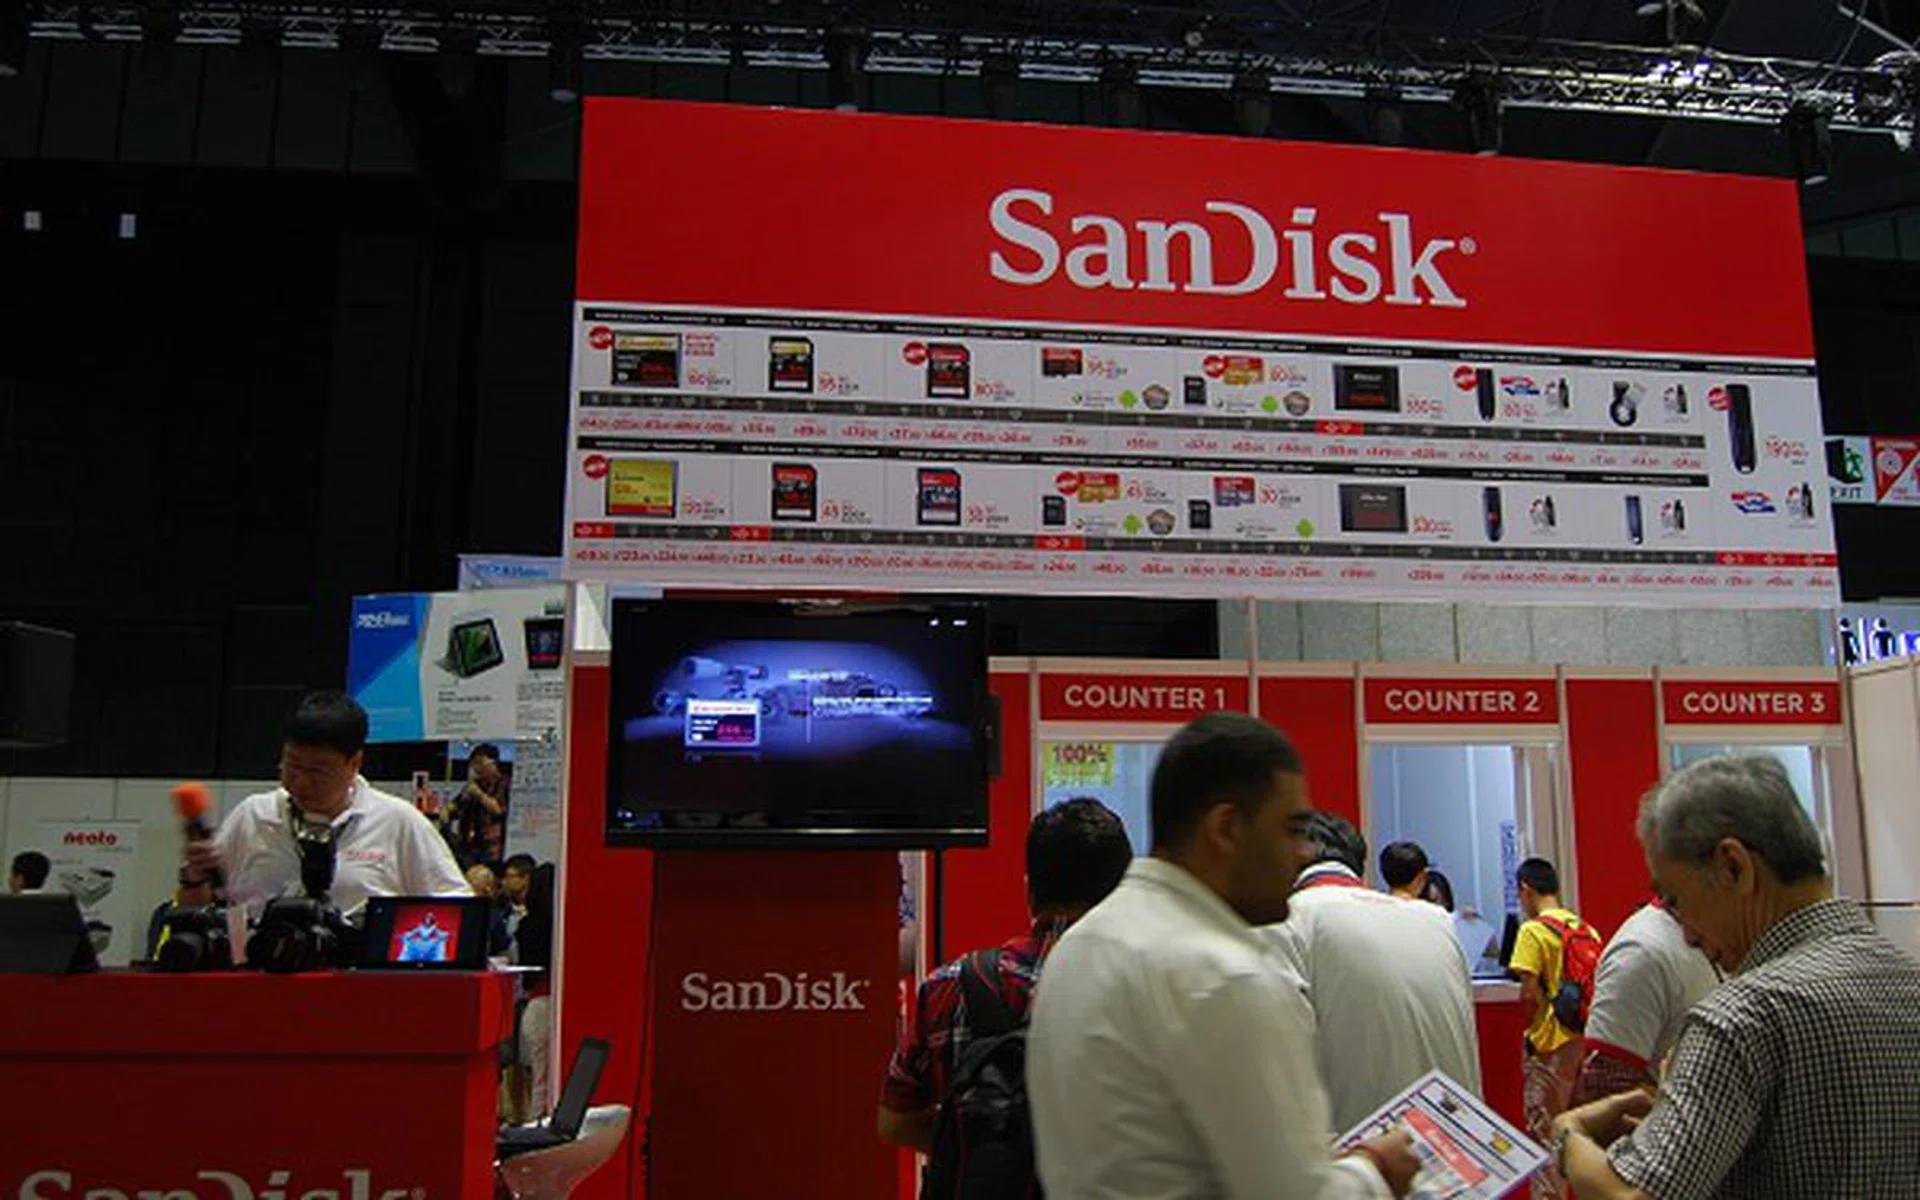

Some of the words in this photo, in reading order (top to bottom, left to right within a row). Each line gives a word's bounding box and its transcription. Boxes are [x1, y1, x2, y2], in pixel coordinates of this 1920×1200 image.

[1063, 684, 1205, 709] COUNTER
[1214, 687, 1225, 709] 1
[1384, 689, 1516, 712] COUNTER
[1523, 691, 1540, 712] 2
[1682, 691, 1804, 713] COUNTER
[1811, 692, 1825, 713] 3
[64, 830, 117, 846] neato
